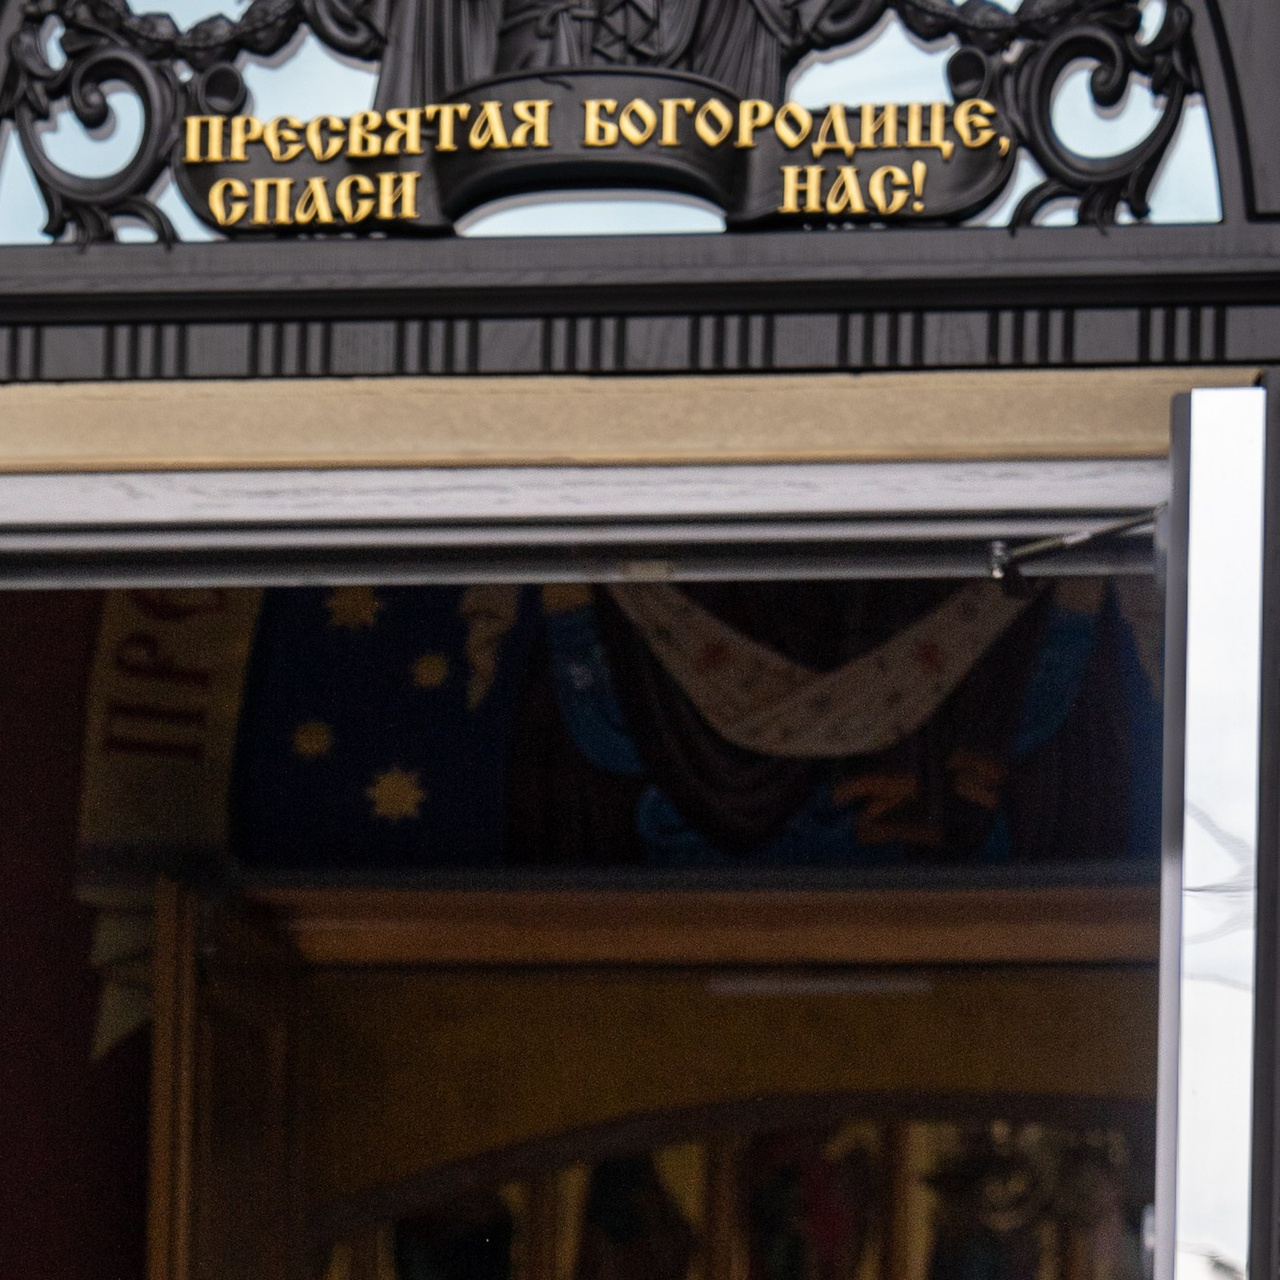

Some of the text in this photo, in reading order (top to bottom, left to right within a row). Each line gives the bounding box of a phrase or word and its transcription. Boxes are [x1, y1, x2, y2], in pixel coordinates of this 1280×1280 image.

[183, 97, 1012, 164] ПРЕСВЯТАЯ БОГОРОДИЦЕ,
[207, 159, 929, 226] СПАСИ НАС!
